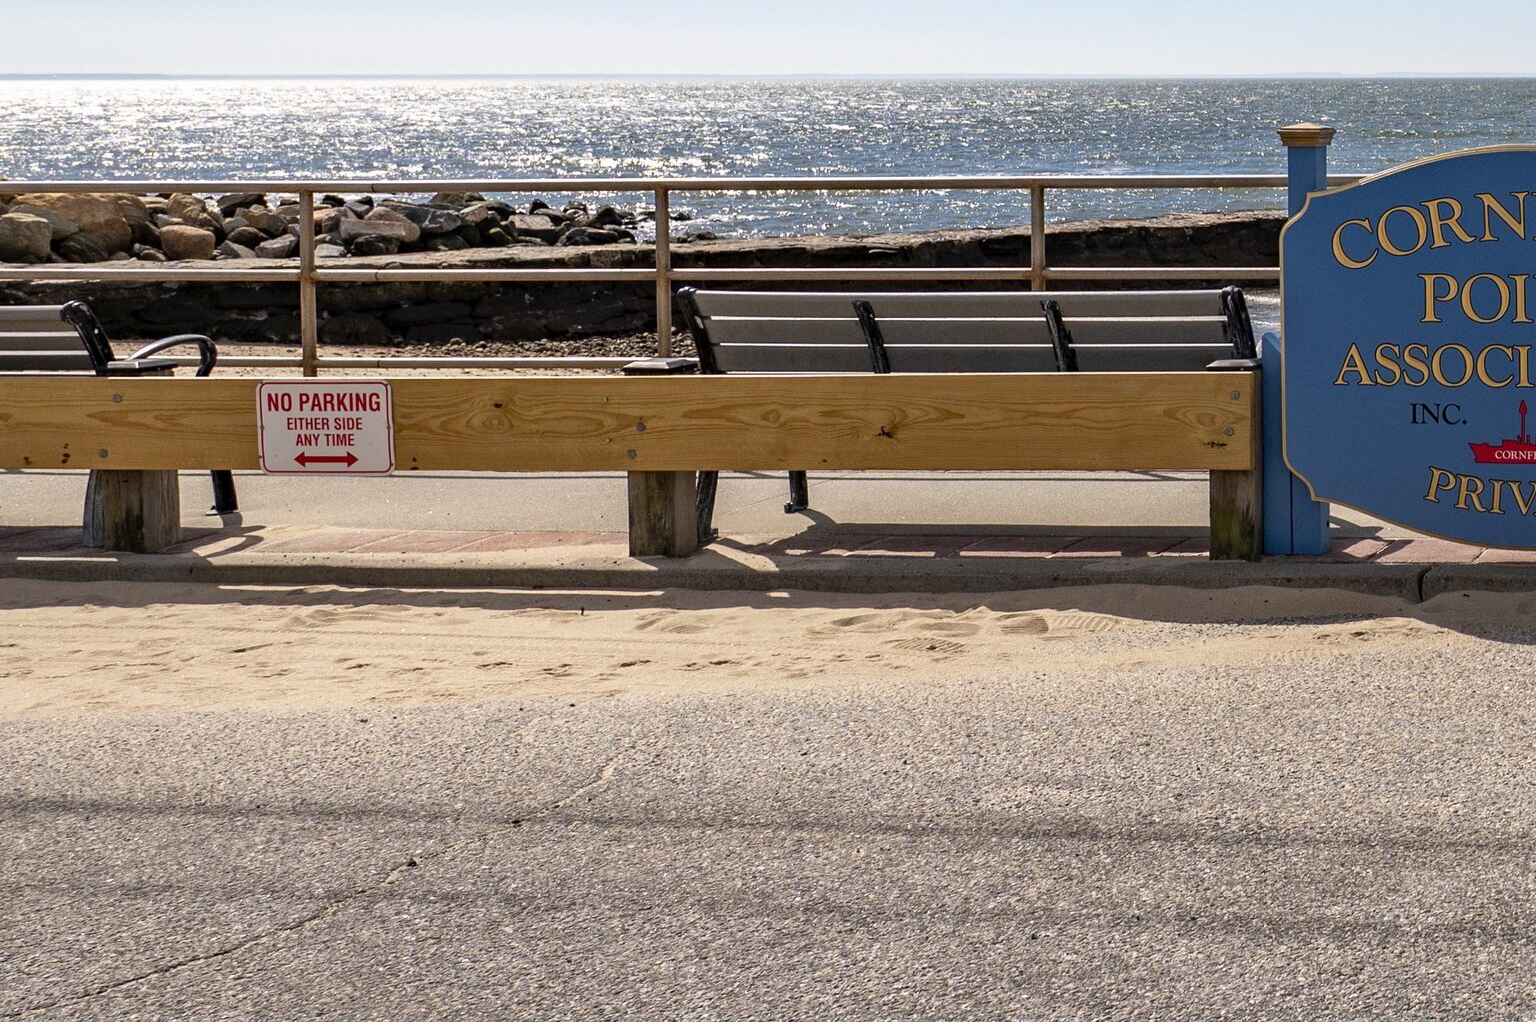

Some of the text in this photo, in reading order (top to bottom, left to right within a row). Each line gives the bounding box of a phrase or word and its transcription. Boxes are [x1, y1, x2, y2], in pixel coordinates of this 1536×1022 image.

[267, 393, 381, 412] NO PARKING
[1410, 402, 1468, 426] INC.
[287, 418, 363, 431] EITHER SIDE
[296, 433, 355, 447] ANY TIME
